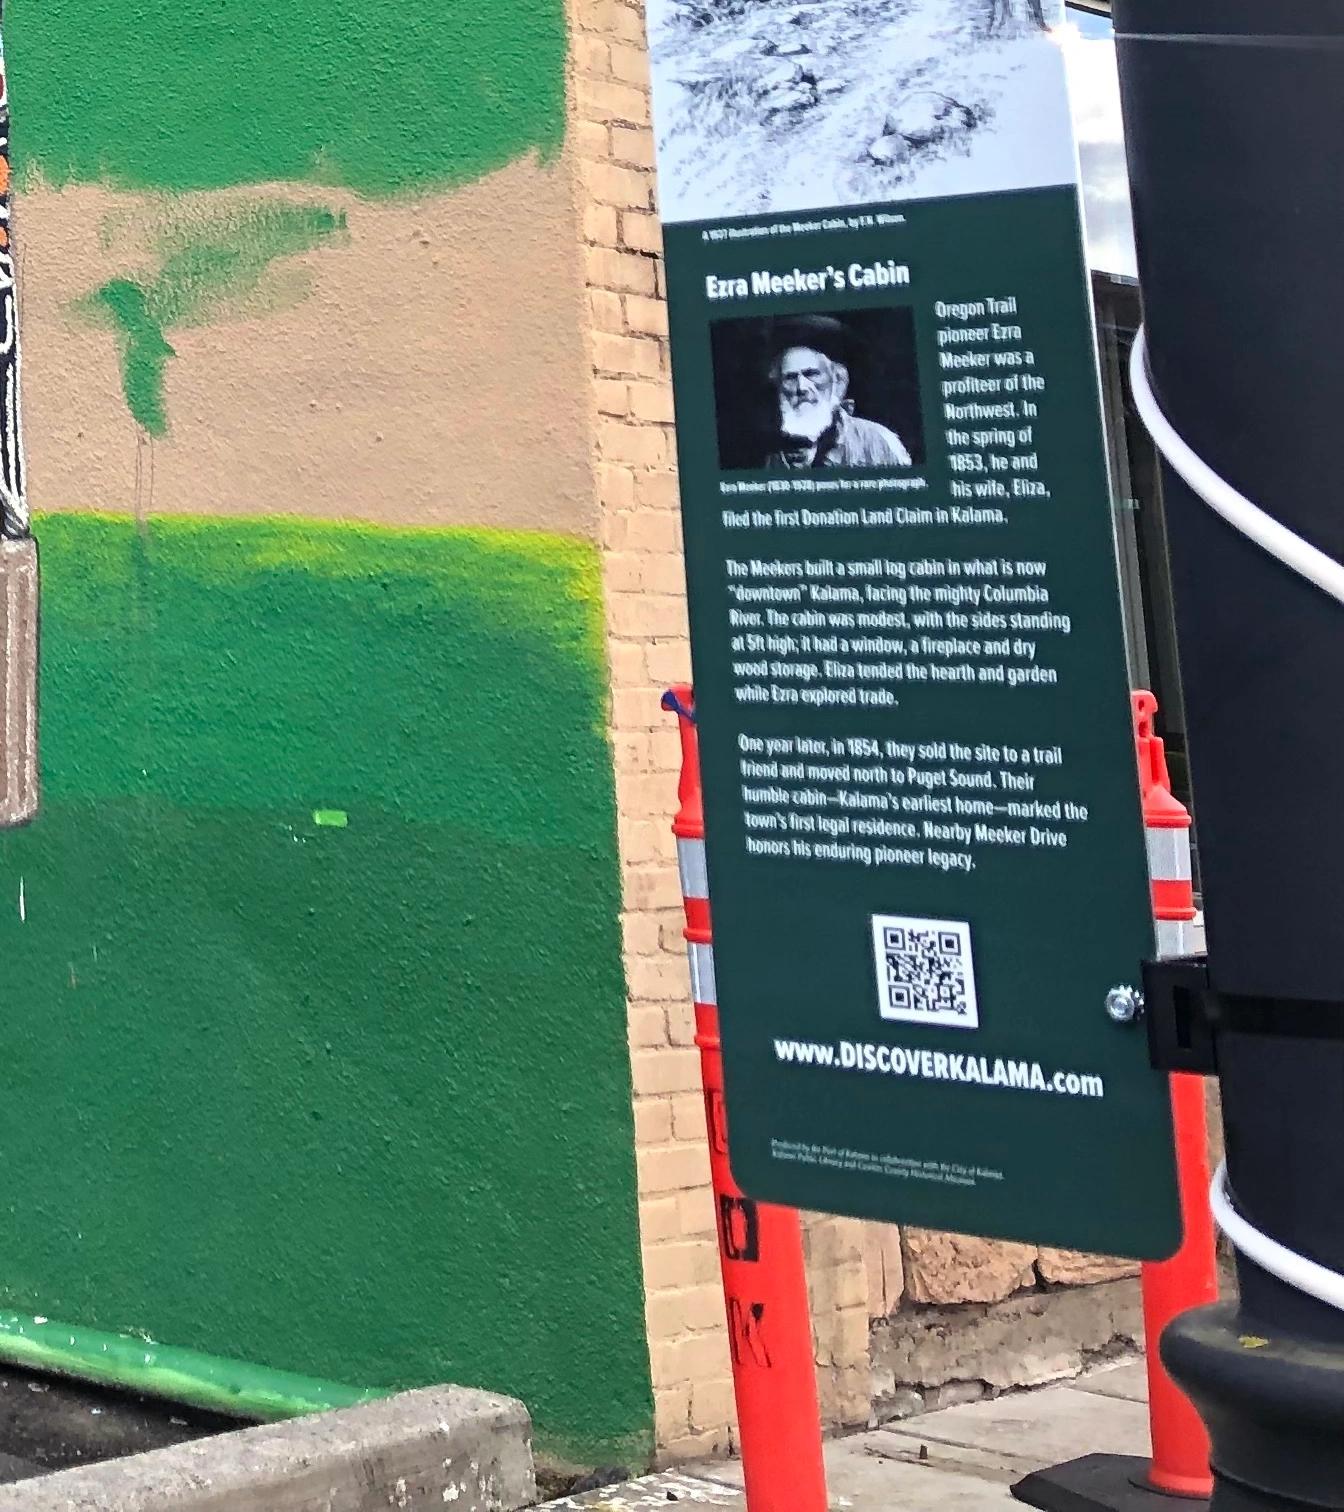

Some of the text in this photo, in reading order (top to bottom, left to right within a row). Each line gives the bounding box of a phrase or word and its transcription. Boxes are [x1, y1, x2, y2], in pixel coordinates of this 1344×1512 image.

[705, 260, 909, 298] Ezra Meeker's Cabin
[935, 296, 1017, 320] Oregon Trail
[937, 323, 1022, 346] pioneer Ezra
[939, 351, 1034, 368] Meeker was a
[941, 374, 1045, 397] profiteer of the
[1022, 400, 1037, 416] In
[945, 425, 1032, 447] the spring of
[989, 453, 1008, 470] he
[1010, 452, 1038, 470] and
[950, 480, 972, 497] his
[722, 510, 750, 527] filed
[751, 510, 772, 526] the
[774, 509, 800, 526] first
[801, 508, 859, 525] Donation
[860, 507, 893, 525] Land
[895, 507, 933, 524] Claim
[934, 507, 949, 523] in
[725, 558, 1046, 579] The Meekers built a small log cabin in what is now
[865, 584, 907, 605] facing
[907, 584, 931, 602] the
[933, 584, 980, 606] mighty
[983, 584, 1048, 602] Columbia
[765, 608, 789, 626] The
[790, 609, 826, 626] cabin
[827, 613, 855, 627] was
[912, 610, 943, 628] with
[945, 611, 968, 628] the
[971, 611, 1007, 629] sides
[1010, 611, 1070, 633] standing
[731, 635, 745, 652] at
[800, 635, 811, 652] it
[812, 635, 838, 652] had
[839, 638, 849, 652] a
[908, 639, 919, 654] a
[921, 636, 981, 657] fireplace
[983, 638, 1010, 655] and
[1013, 638, 1035, 660] dry
[732, 660, 768, 676] wood
[823, 660, 855, 678] Eliza
[856, 662, 903, 679] tended
[905, 662, 928, 679] the
[930, 663, 975, 681] hearth
[978, 664, 1004, 681] and
[1007, 665, 1057, 686] garden
[734, 684, 769, 701] while
[770, 684, 798, 703] Ezra
[800, 686, 856, 706] explored
[737, 733, 764, 752] One
[764, 738, 793, 756] year
[830, 738, 845, 755] in
[885, 740, 915, 762] they
[918, 742, 946, 759] sold
[949, 743, 972, 761] the
[974, 743, 1000, 762] site
[1002, 745, 1018, 762] to
[1021, 748, 1030, 763] a
[1033, 746, 1062, 764] trail
[740, 759, 778, 778] friend
[779, 762, 804, 779] and
[806, 764, 850, 781] moved
[853, 766, 888, 783] north
[890, 767, 905, 784] to
[907, 766, 946, 788] Puget
[999, 771, 1034, 790] Their
[742, 785, 789, 803] humble
[901, 794, 952, 813] earliest
[1064, 802, 1088, 820] the
[744, 811, 787, 829] town's
[788, 812, 815, 831] first
[816, 815, 850, 836] legal
[923, 820, 971, 844] Nearby
[974, 823, 1026, 843] Meeker
[1030, 826, 1067, 847] Drive
[745, 836, 790, 855] honors
[791, 839, 812, 857] his
[813, 842, 871, 864] enduring
[874, 846, 924, 864] pioneer
[774, 1039, 1103, 1097] www.DISCOVERKALAMA.com
